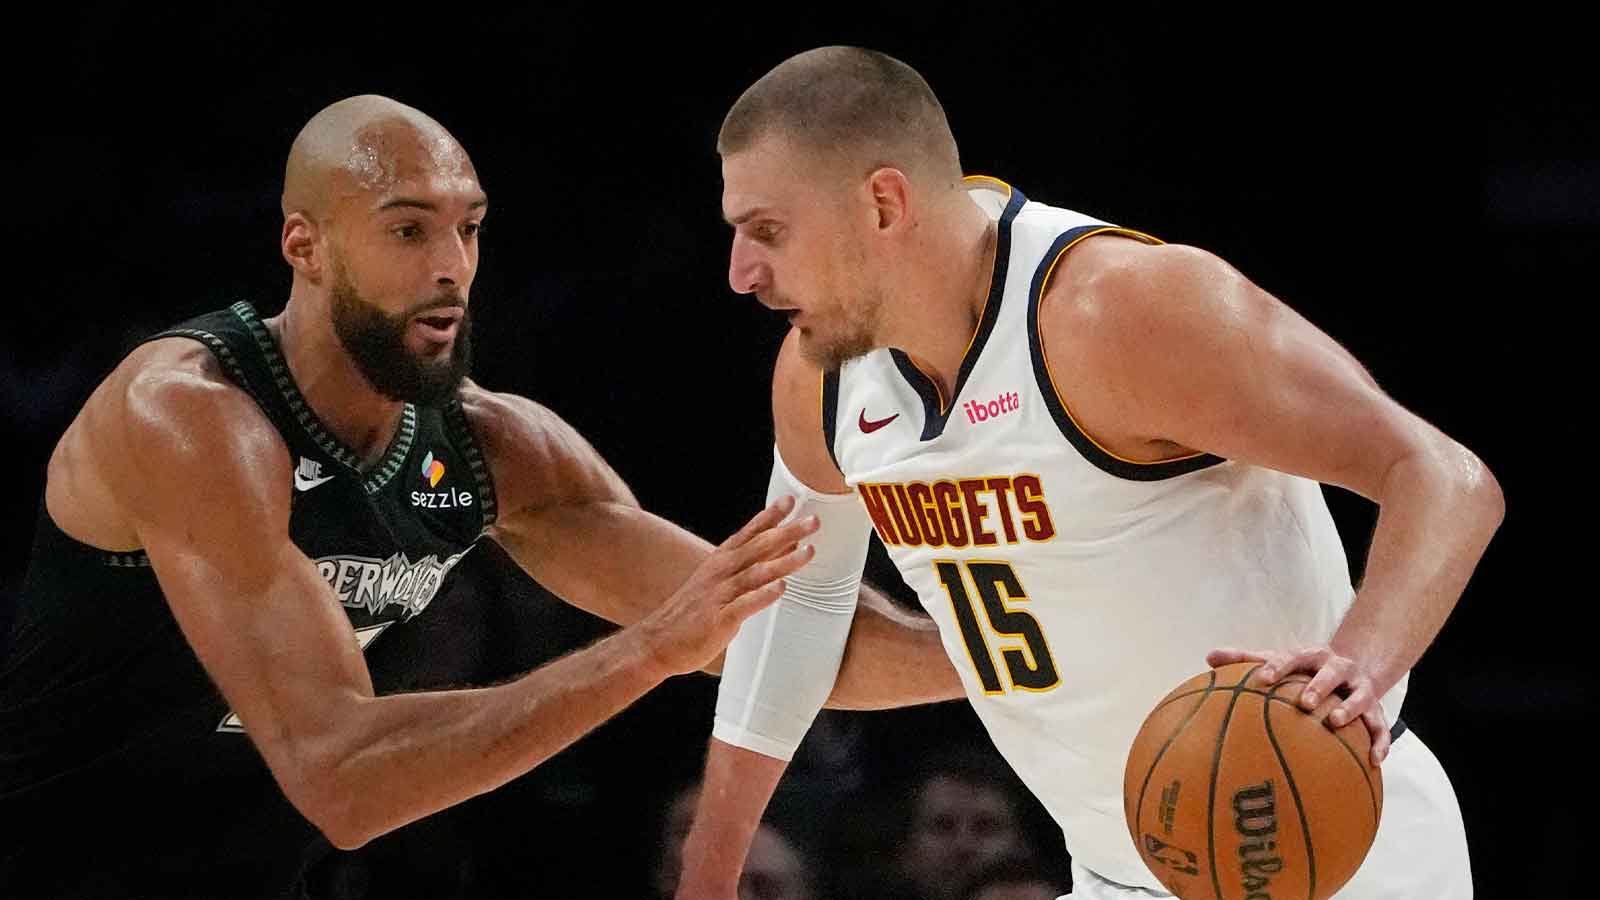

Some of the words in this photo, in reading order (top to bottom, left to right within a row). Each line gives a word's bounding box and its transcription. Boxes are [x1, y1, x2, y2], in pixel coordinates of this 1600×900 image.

[963, 391, 1020, 424] ibotta
[411, 487, 473, 508] sezzle
[858, 473, 1057, 548] NUGGETS
[932, 558, 1062, 697] 15
